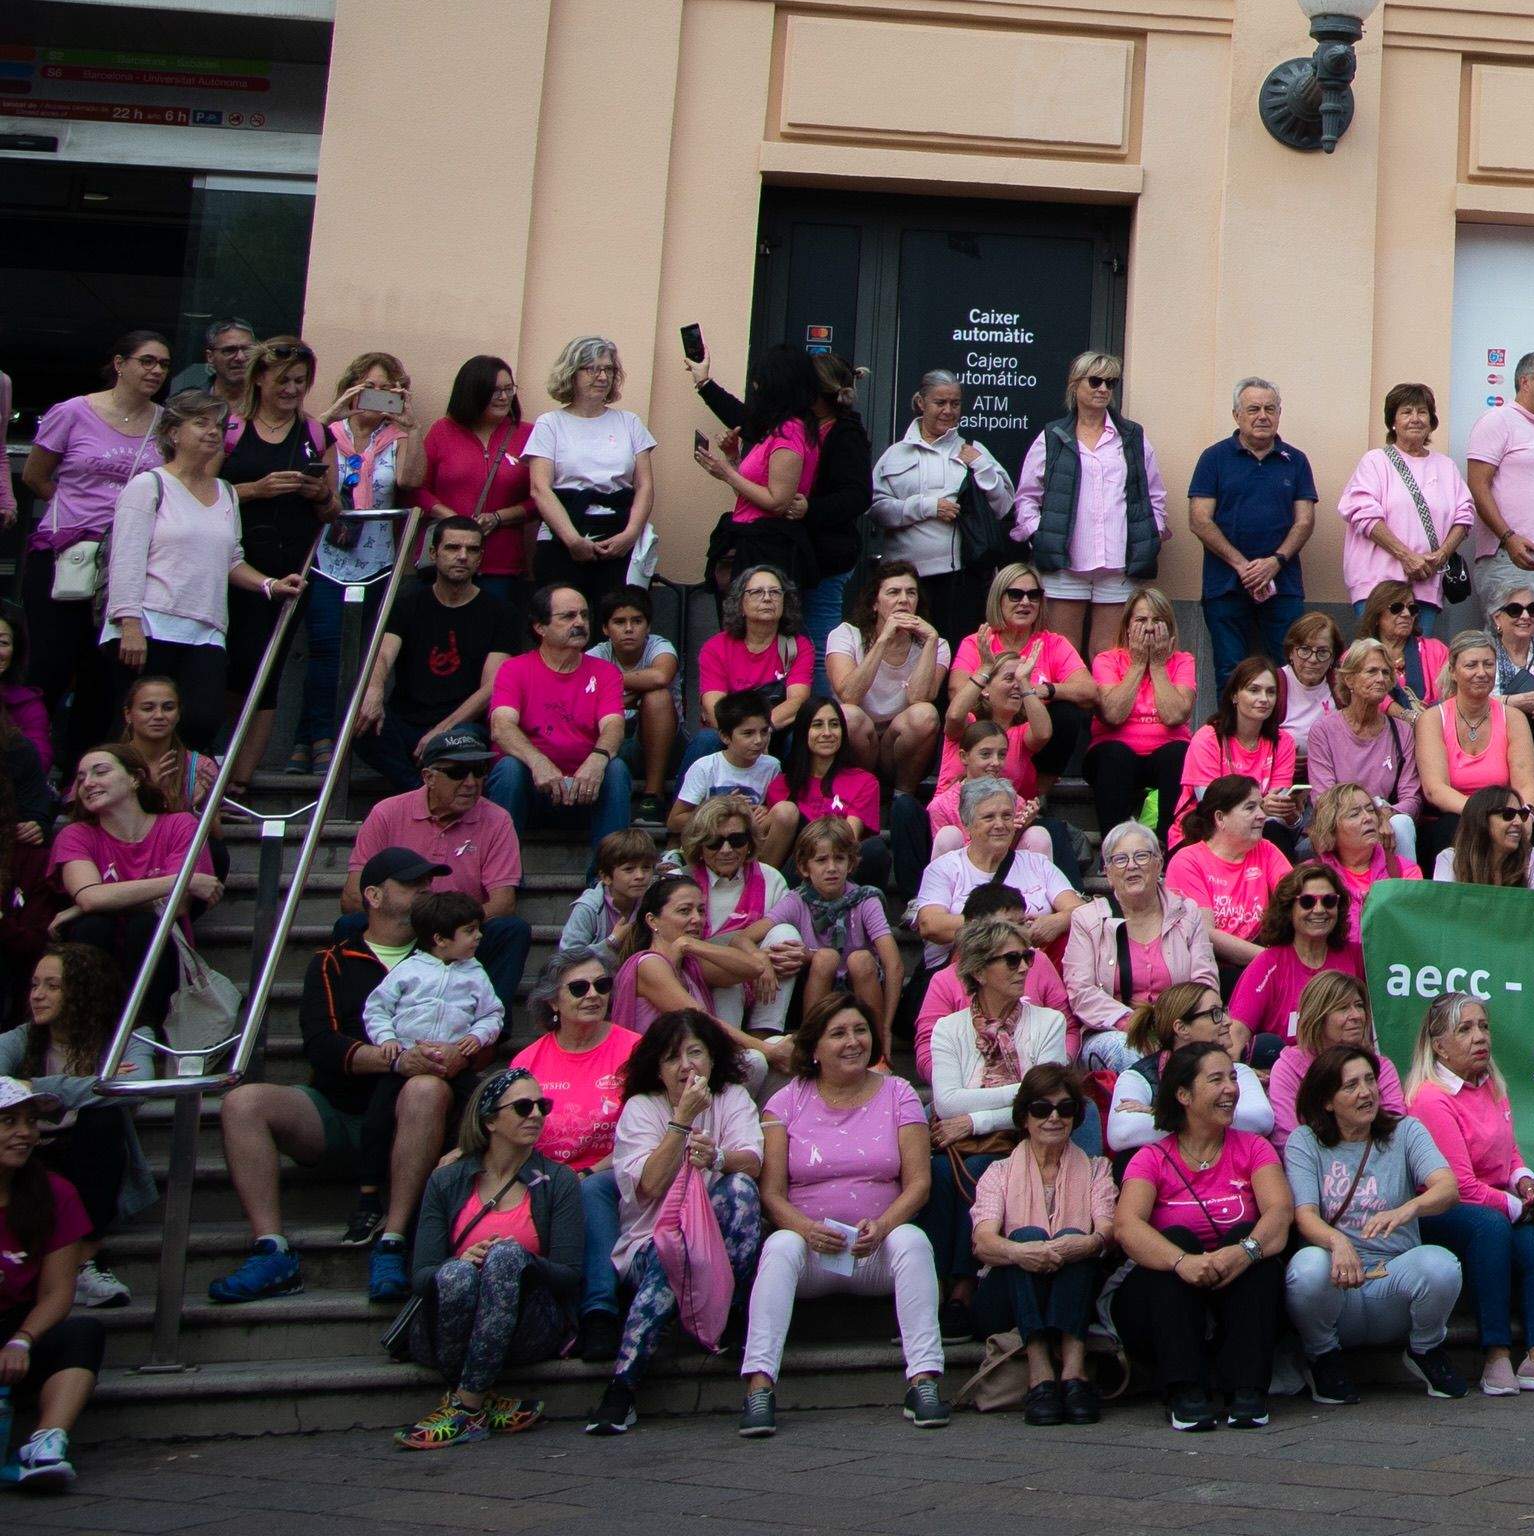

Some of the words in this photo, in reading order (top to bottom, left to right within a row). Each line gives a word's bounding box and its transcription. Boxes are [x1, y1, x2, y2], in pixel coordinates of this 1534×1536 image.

[47, 68, 62, 78] S6
[83, 69, 133, 81] Barcelona
[143, 73, 197, 86] Universitat
[112, 106, 130, 120] 22
[133, 108, 143, 121] h
[165, 110, 174, 122] 6
[177, 111, 187, 123] h
[968, 309, 1020, 325] Caixer
[952, 325, 1035, 344] automàtic
[966, 352, 1018, 371] Cajero
[955, 370, 1037, 387] utomático
[972, 396, 1009, 411] ATM
[956, 413, 1029, 431] ashpoint
[1386, 962, 1491, 997] aecc
